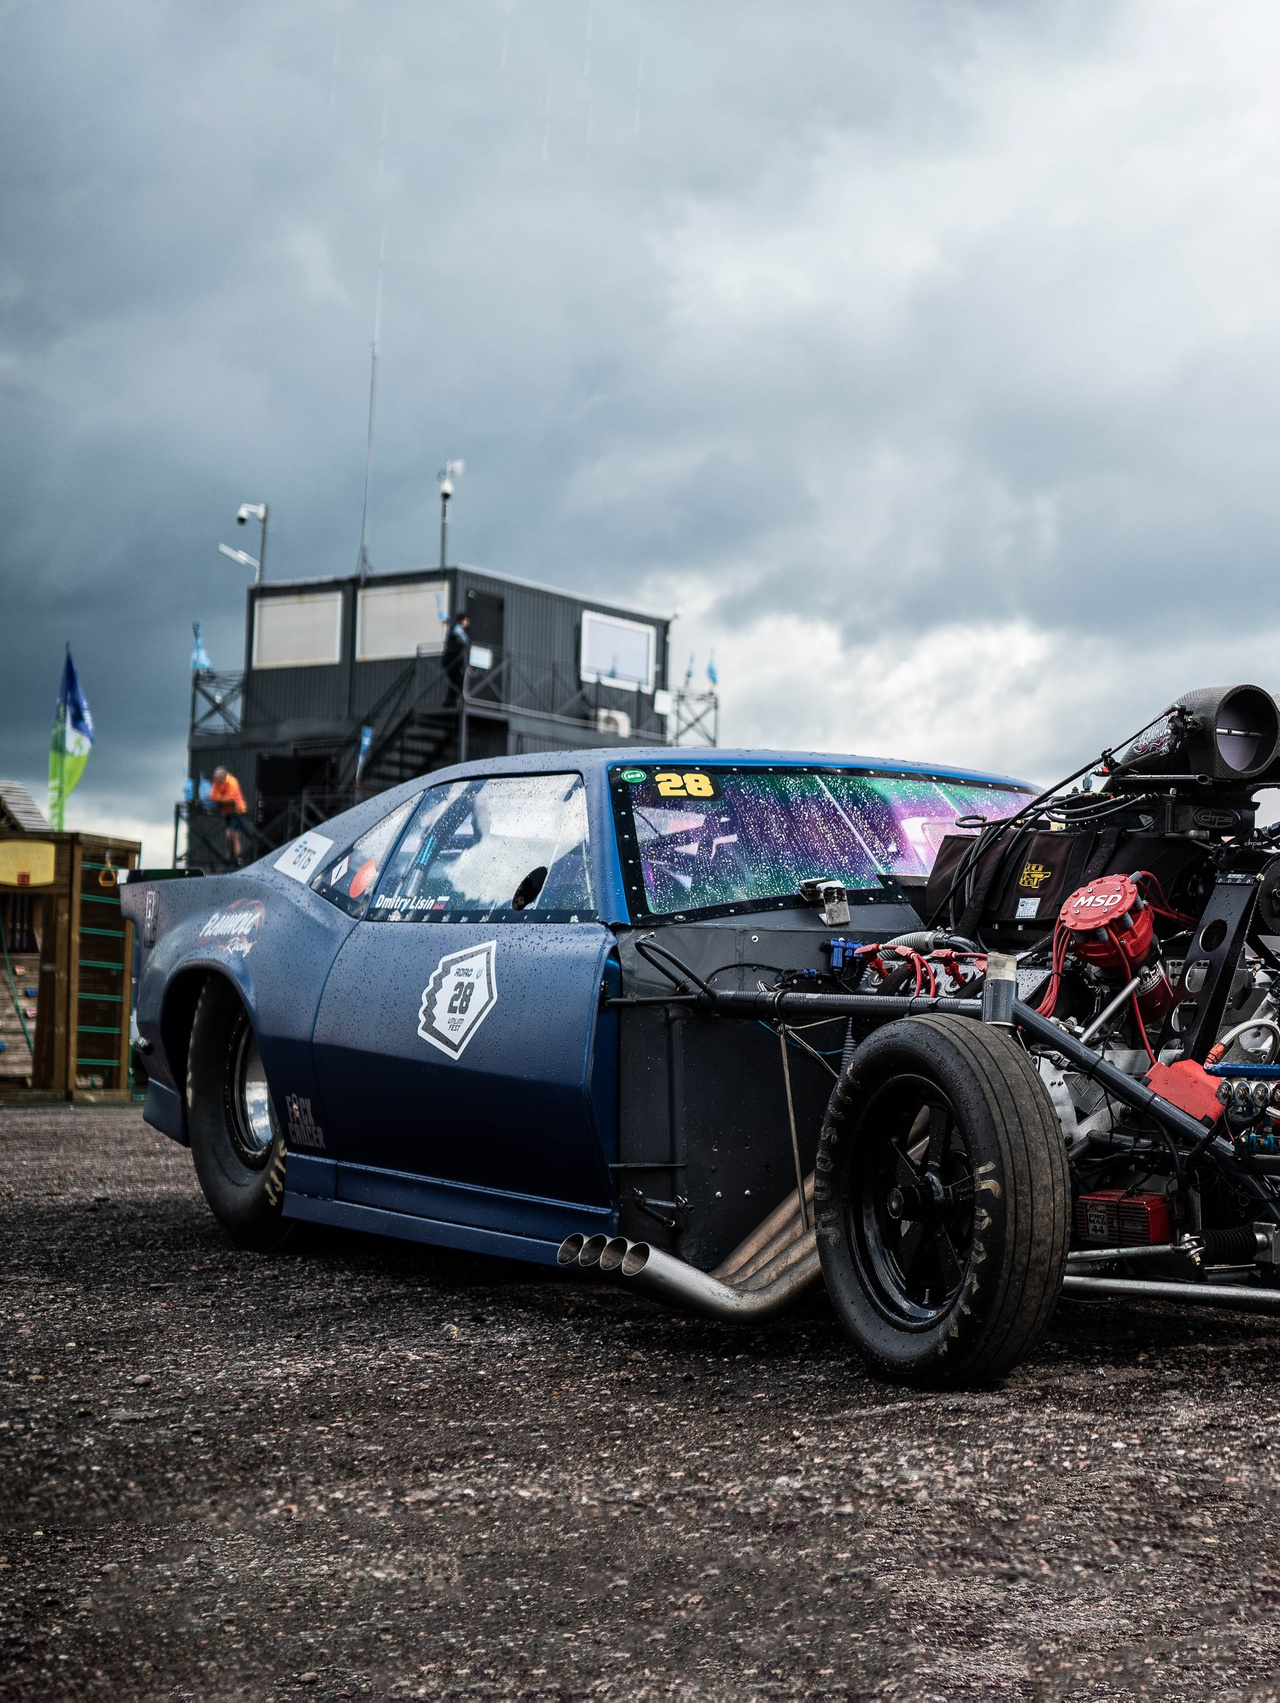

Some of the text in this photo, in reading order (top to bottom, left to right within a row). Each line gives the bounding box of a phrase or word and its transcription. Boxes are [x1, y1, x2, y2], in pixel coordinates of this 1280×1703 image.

[654, 773, 715, 797] 28
[292, 846, 317, 870] ВТБ
[375, 894, 436, 912] Dmitry Lisin
[1072, 894, 1123, 908] MSD
[447, 981, 475, 1015] 28
[1091, 1225, 1105, 1234] 44
